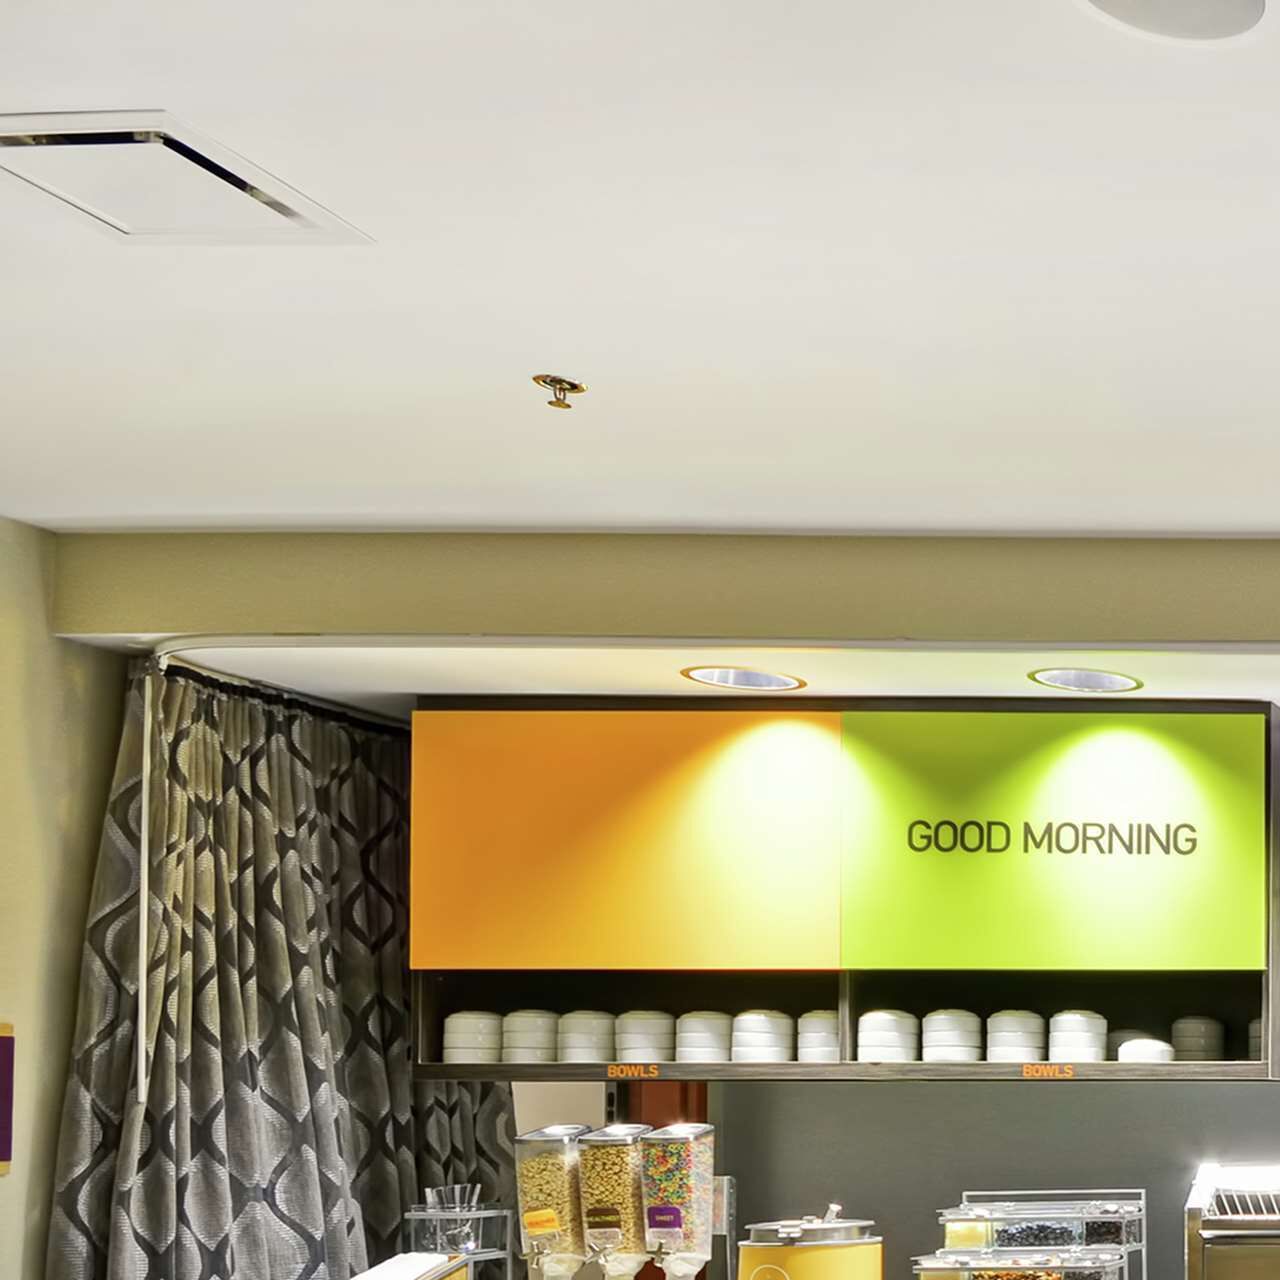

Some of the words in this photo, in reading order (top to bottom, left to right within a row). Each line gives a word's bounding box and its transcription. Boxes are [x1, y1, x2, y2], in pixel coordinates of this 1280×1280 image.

[908, 819, 1011, 853] GOOD
[1023, 821, 1198, 855] MORNING
[607, 1064, 659, 1078] BOWLS
[1023, 1064, 1073, 1078] BOWLS
